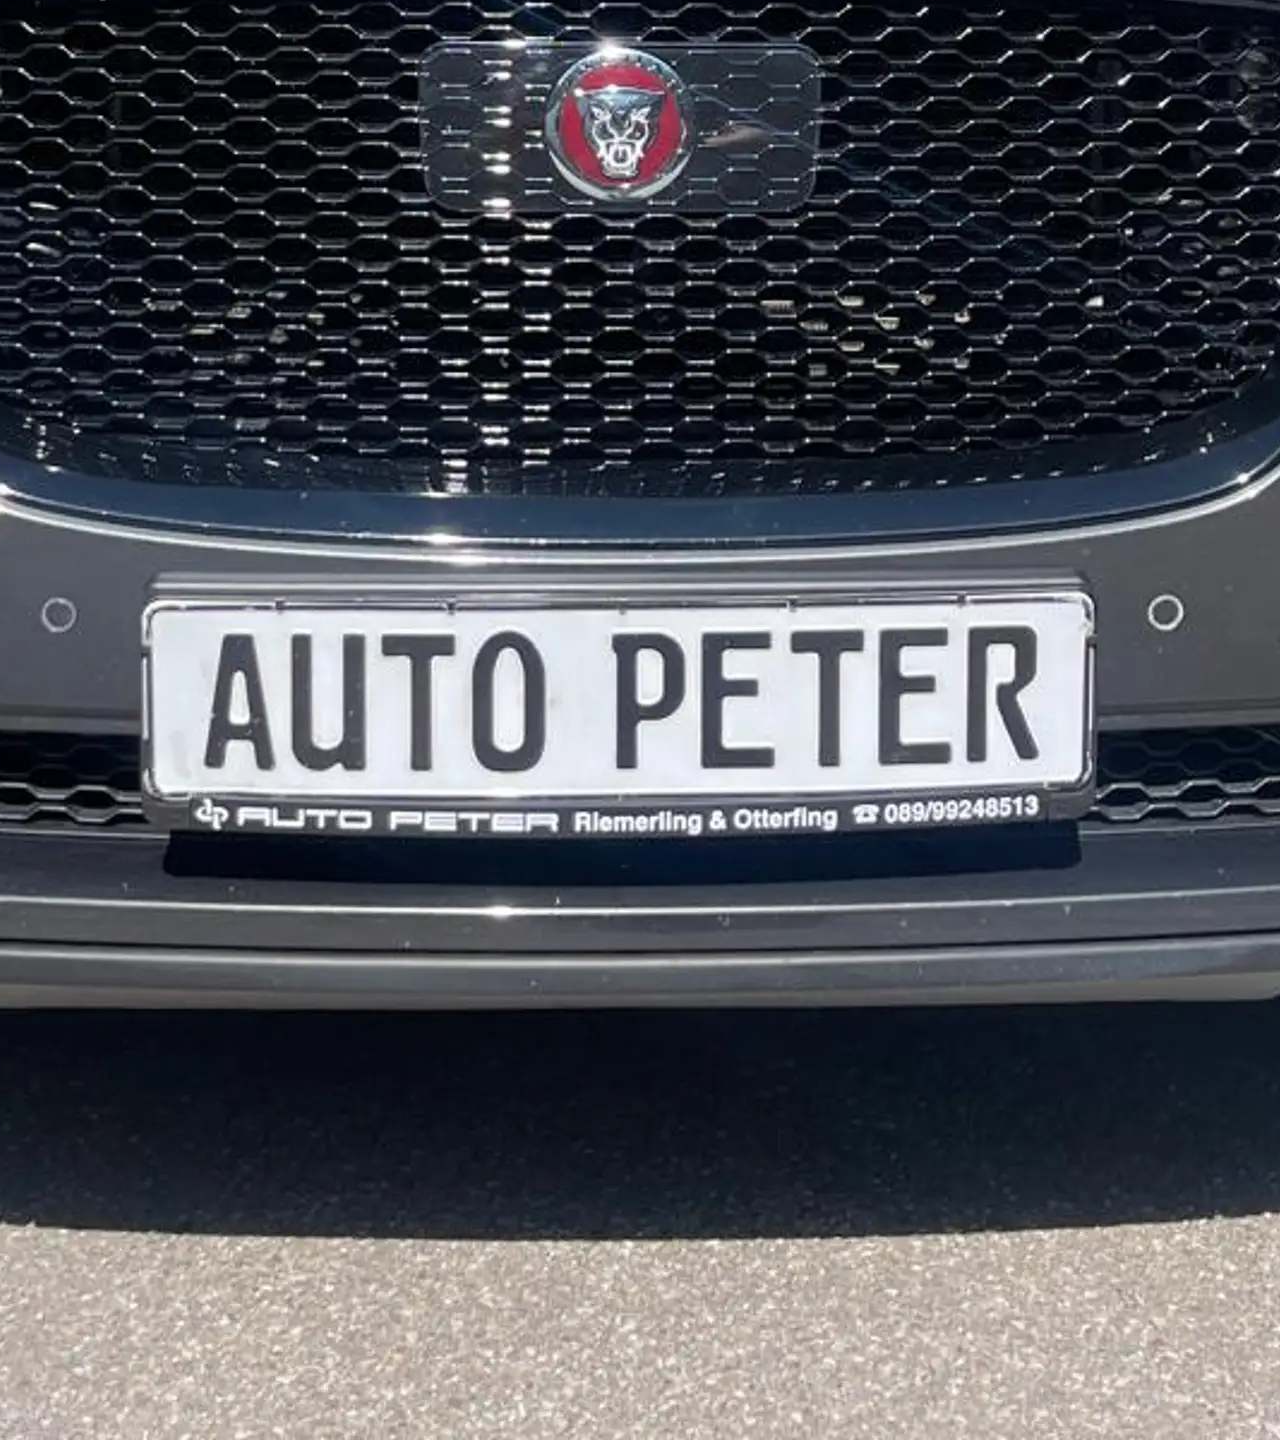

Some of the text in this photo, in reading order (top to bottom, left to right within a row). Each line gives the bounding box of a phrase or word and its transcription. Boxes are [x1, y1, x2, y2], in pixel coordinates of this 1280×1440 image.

[203, 625, 1040, 771] AUTO PETER
[237, 807, 373, 829] AUTO
[389, 810, 559, 833] PETER
[573, 810, 702, 836] Riemerling
[710, 810, 727, 830] &
[733, 806, 838, 831] Otterfing
[885, 794, 1040, 824] 089/99248513
